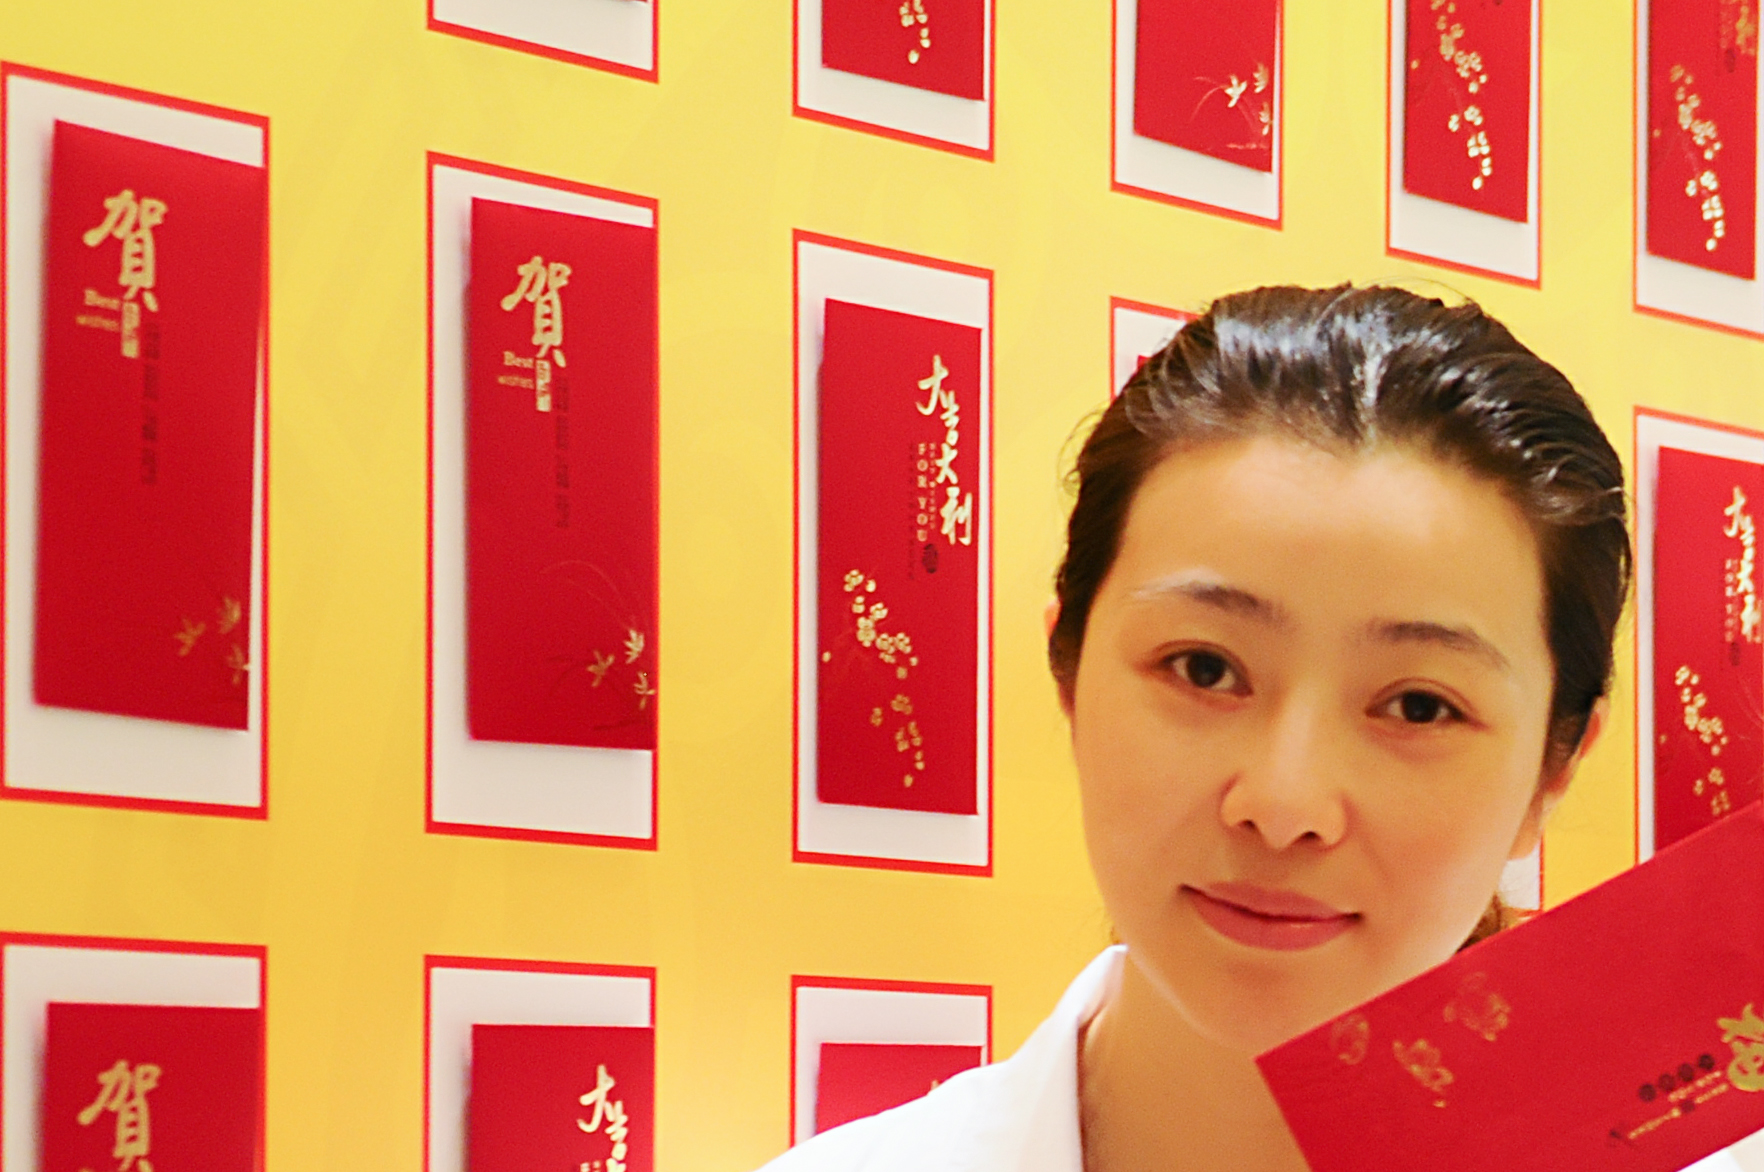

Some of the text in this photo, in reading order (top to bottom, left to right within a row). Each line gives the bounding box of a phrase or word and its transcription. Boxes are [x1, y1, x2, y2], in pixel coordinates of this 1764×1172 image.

[83, 189, 168, 312] 賀
[500, 256, 571, 368] 賀
[916, 354, 972, 546] 大吉大利
